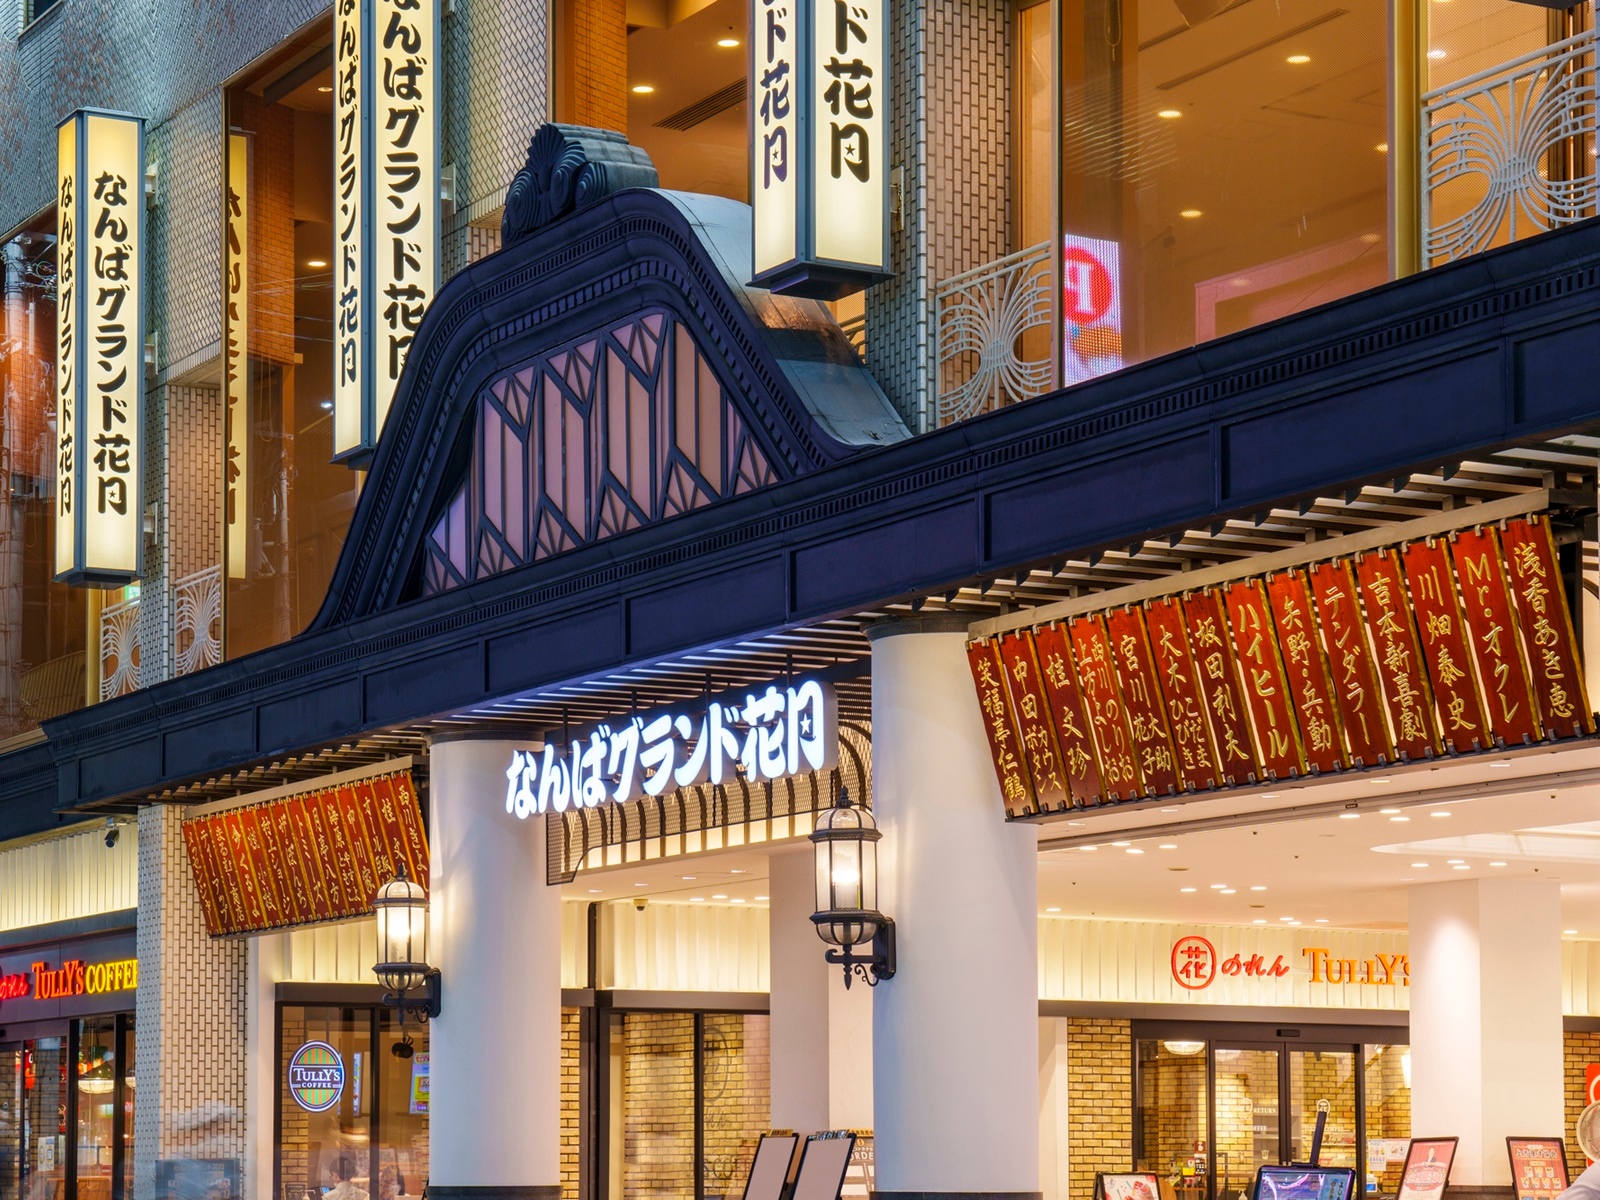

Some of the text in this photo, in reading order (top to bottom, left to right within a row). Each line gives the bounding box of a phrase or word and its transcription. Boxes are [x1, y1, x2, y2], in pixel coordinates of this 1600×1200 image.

[760, 0, 790, 190] ド花月
[58, 175, 75, 518] なんばグランド花月
[93, 170, 134, 516] なんばグランド花月
[1195, 616, 1249, 762] 坂田利夫
[1238, 604, 1289, 759] ハイヒール
[1324, 586, 1370, 745] テンダラー
[1368, 572, 1427, 742] 吉本新喜劇
[1418, 565, 1476, 731] 川畑泰史
[1513, 542, 1575, 718] 浅香あき恵
[505, 679, 826, 820] なんばグランド花月
[977, 656, 1027, 801] 笑福亭仁鶴
[296, 814, 324, 903] トミーズ
[312, 807, 339, 905] 月亭八方
[347, 805, 376, 895] 中川家
[382, 798, 408, 876] 桂文
[32, 960, 85, 1000] TULLY'S
[1221, 953, 1290, 978] のれん
[293, 1068, 341, 1082] TULLY'S
